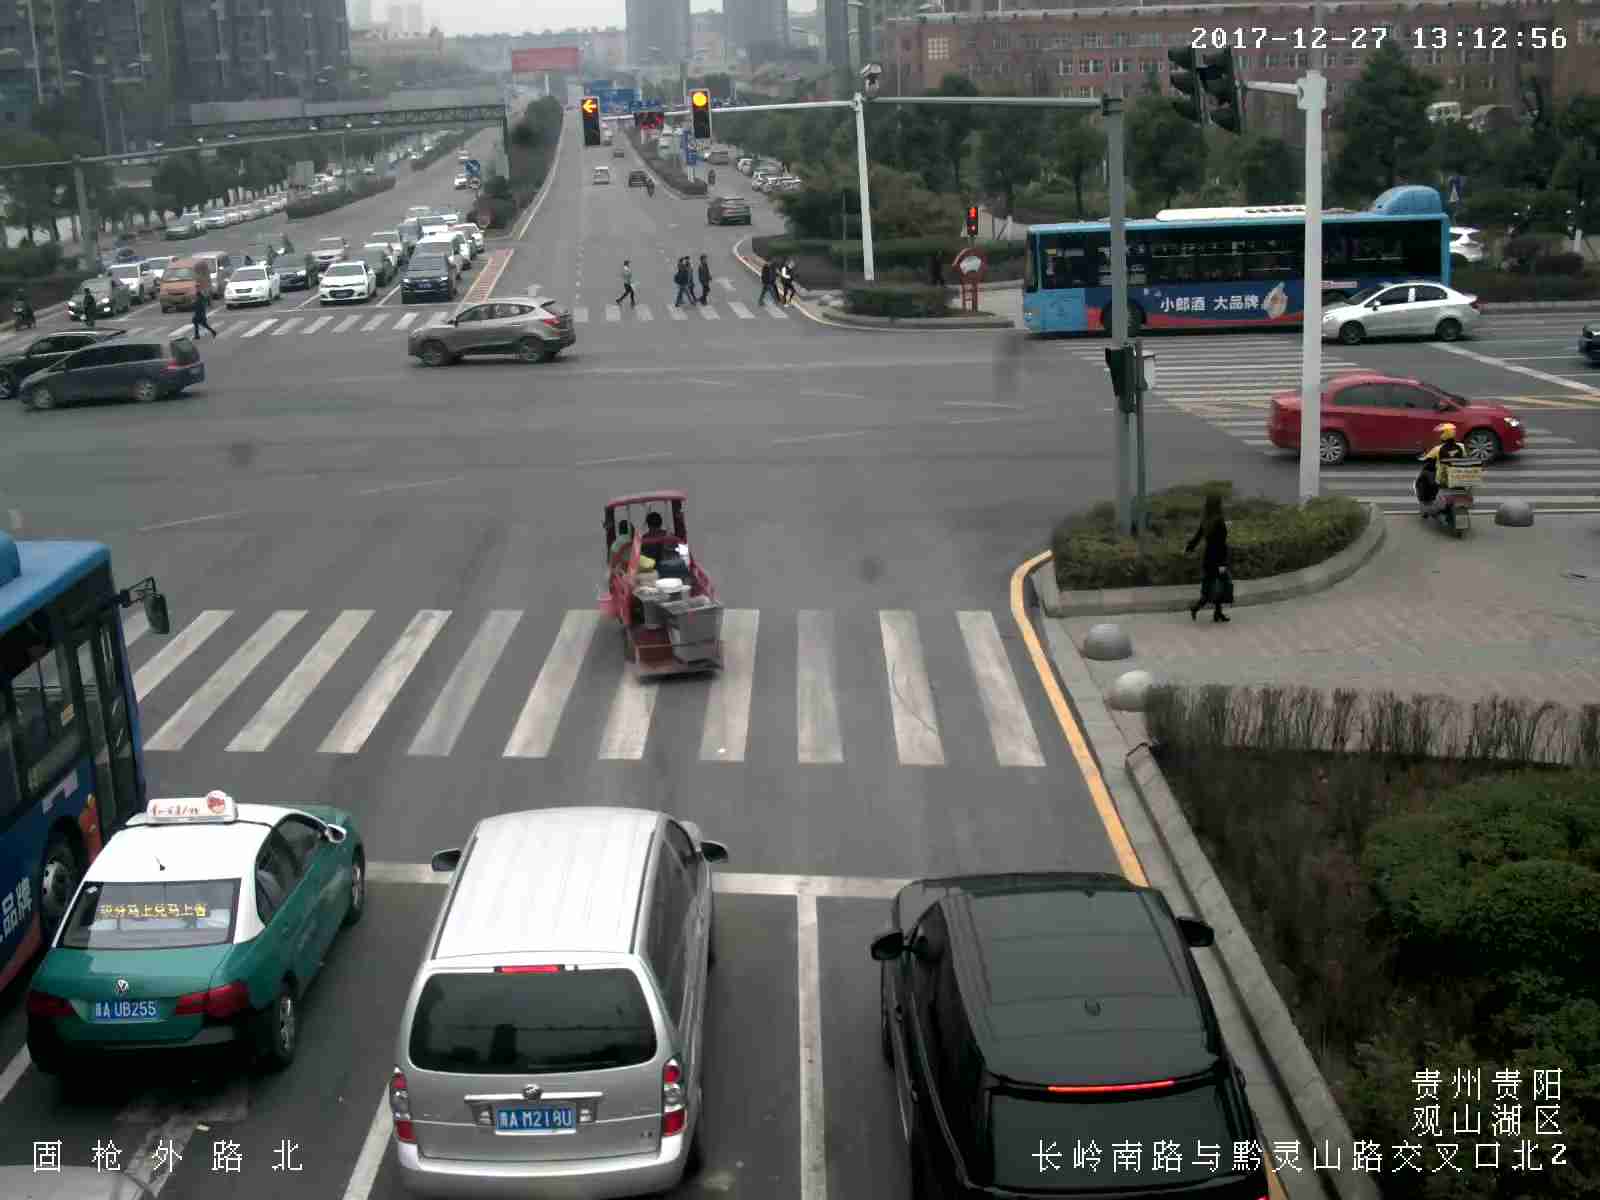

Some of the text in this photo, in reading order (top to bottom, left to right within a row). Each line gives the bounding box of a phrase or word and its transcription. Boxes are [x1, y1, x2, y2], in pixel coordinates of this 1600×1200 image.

[1213, 295, 1259, 311] 大品牌
[0, 876, 32, 943] 品牌
